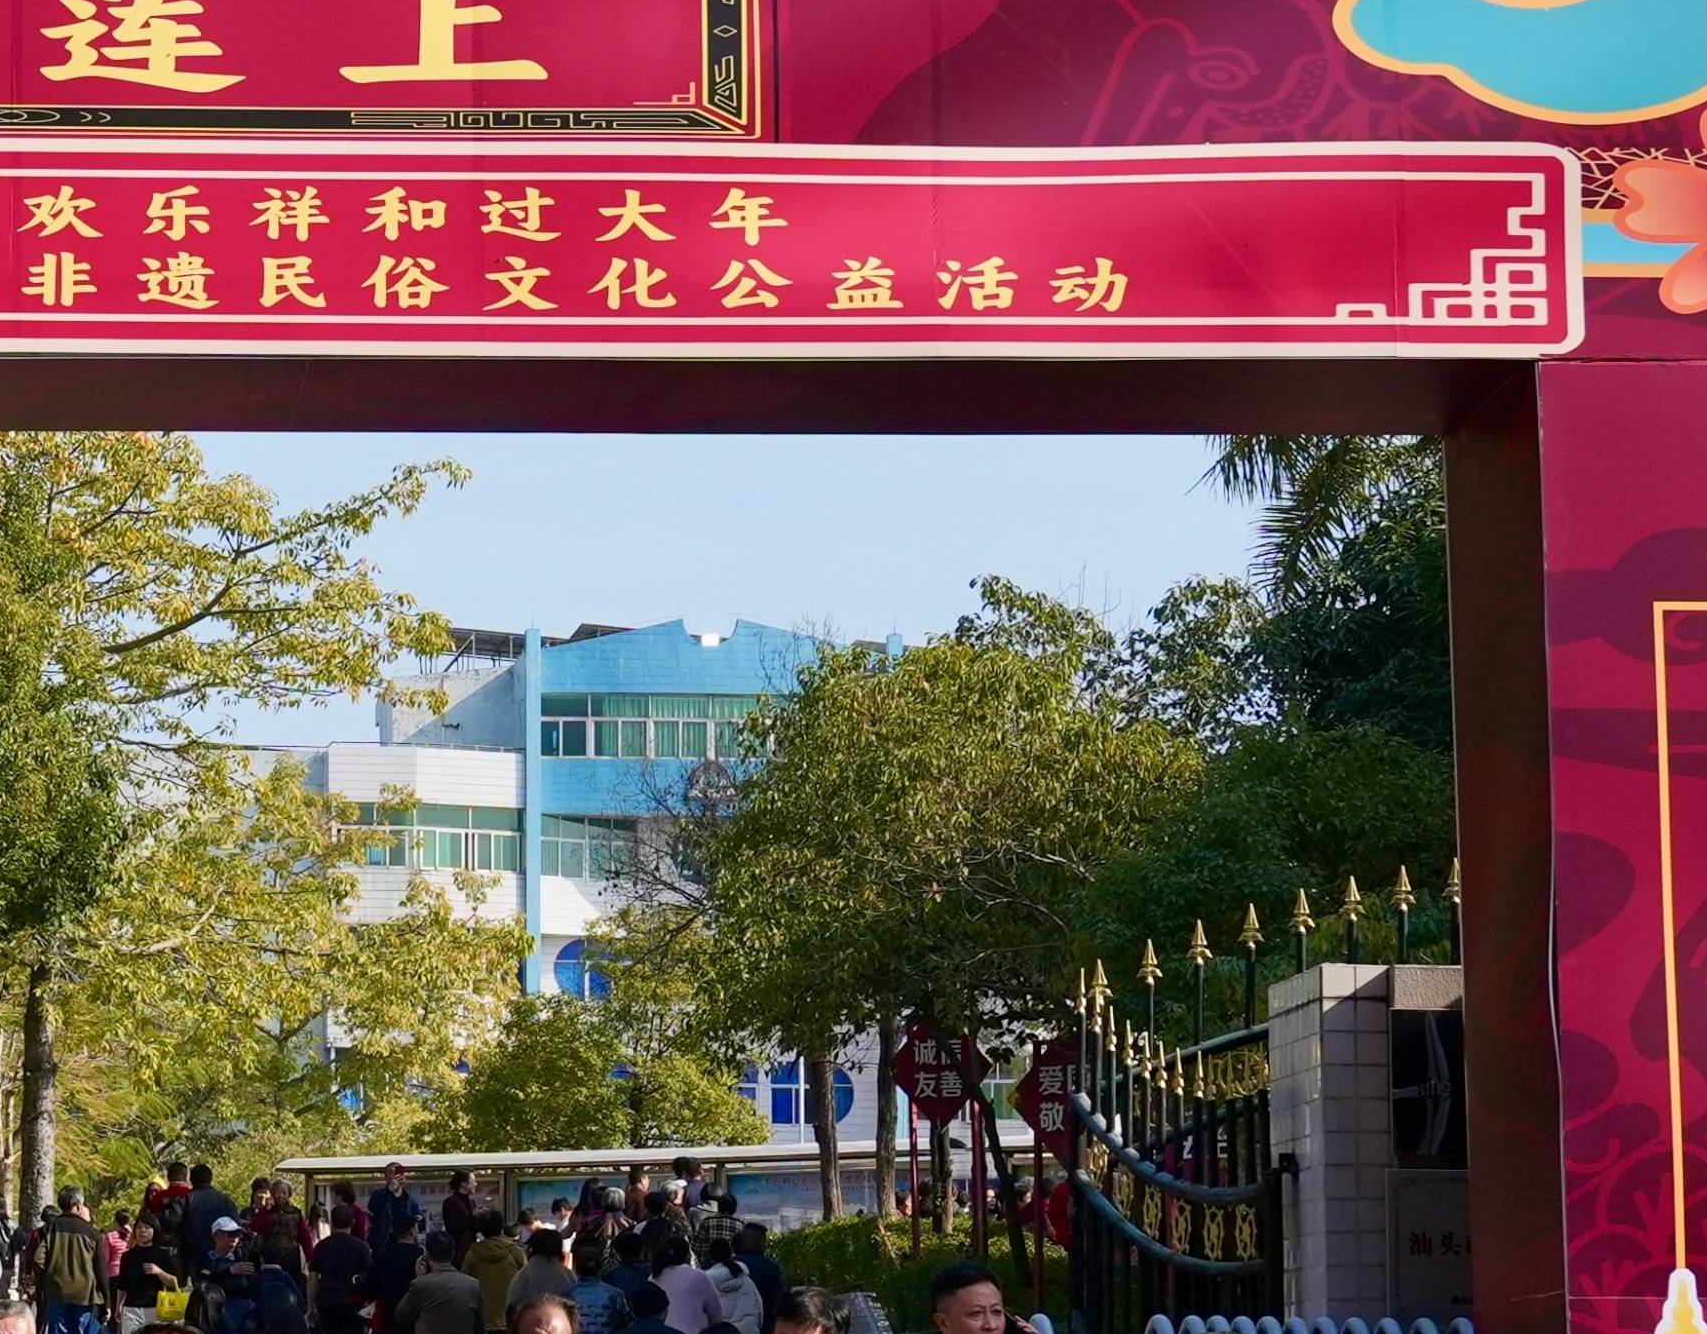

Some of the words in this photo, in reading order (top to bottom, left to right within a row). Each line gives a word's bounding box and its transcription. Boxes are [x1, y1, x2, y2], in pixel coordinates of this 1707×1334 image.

[29, 186, 790, 243] 欢乐祥和过大年
[914, 1070, 963, 1098] 友善
